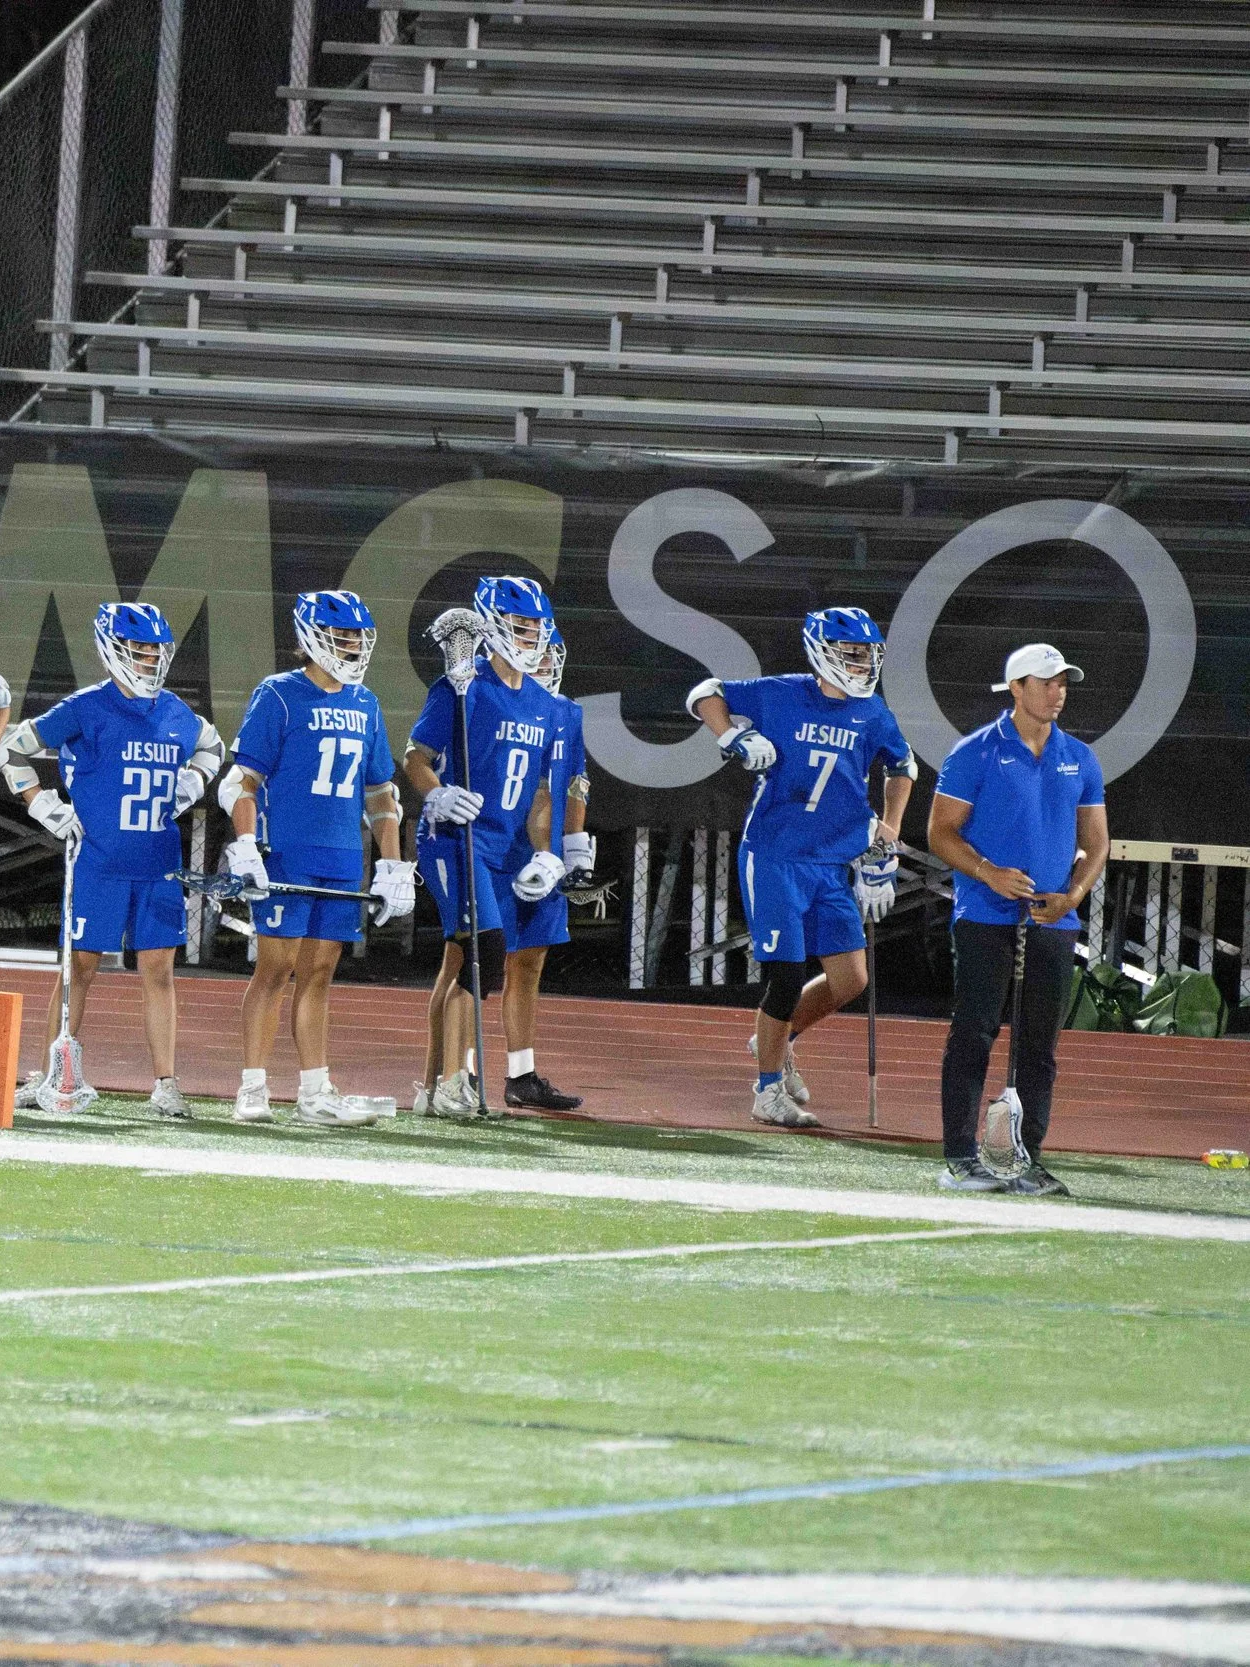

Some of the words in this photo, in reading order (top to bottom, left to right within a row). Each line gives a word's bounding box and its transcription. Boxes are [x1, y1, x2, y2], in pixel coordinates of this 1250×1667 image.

[308, 708, 368, 735] JESUIT
[496, 721, 546, 747] JESUIT
[795, 722, 859, 750] JESUIT
[122, 741, 180, 764] JESUIT
[311, 737, 363, 799] 17
[501, 748, 529, 810] 8
[804, 749, 838, 812] 7
[119, 767, 174, 832] 22
[266, 905, 284, 928] J
[762, 930, 781, 953] J
